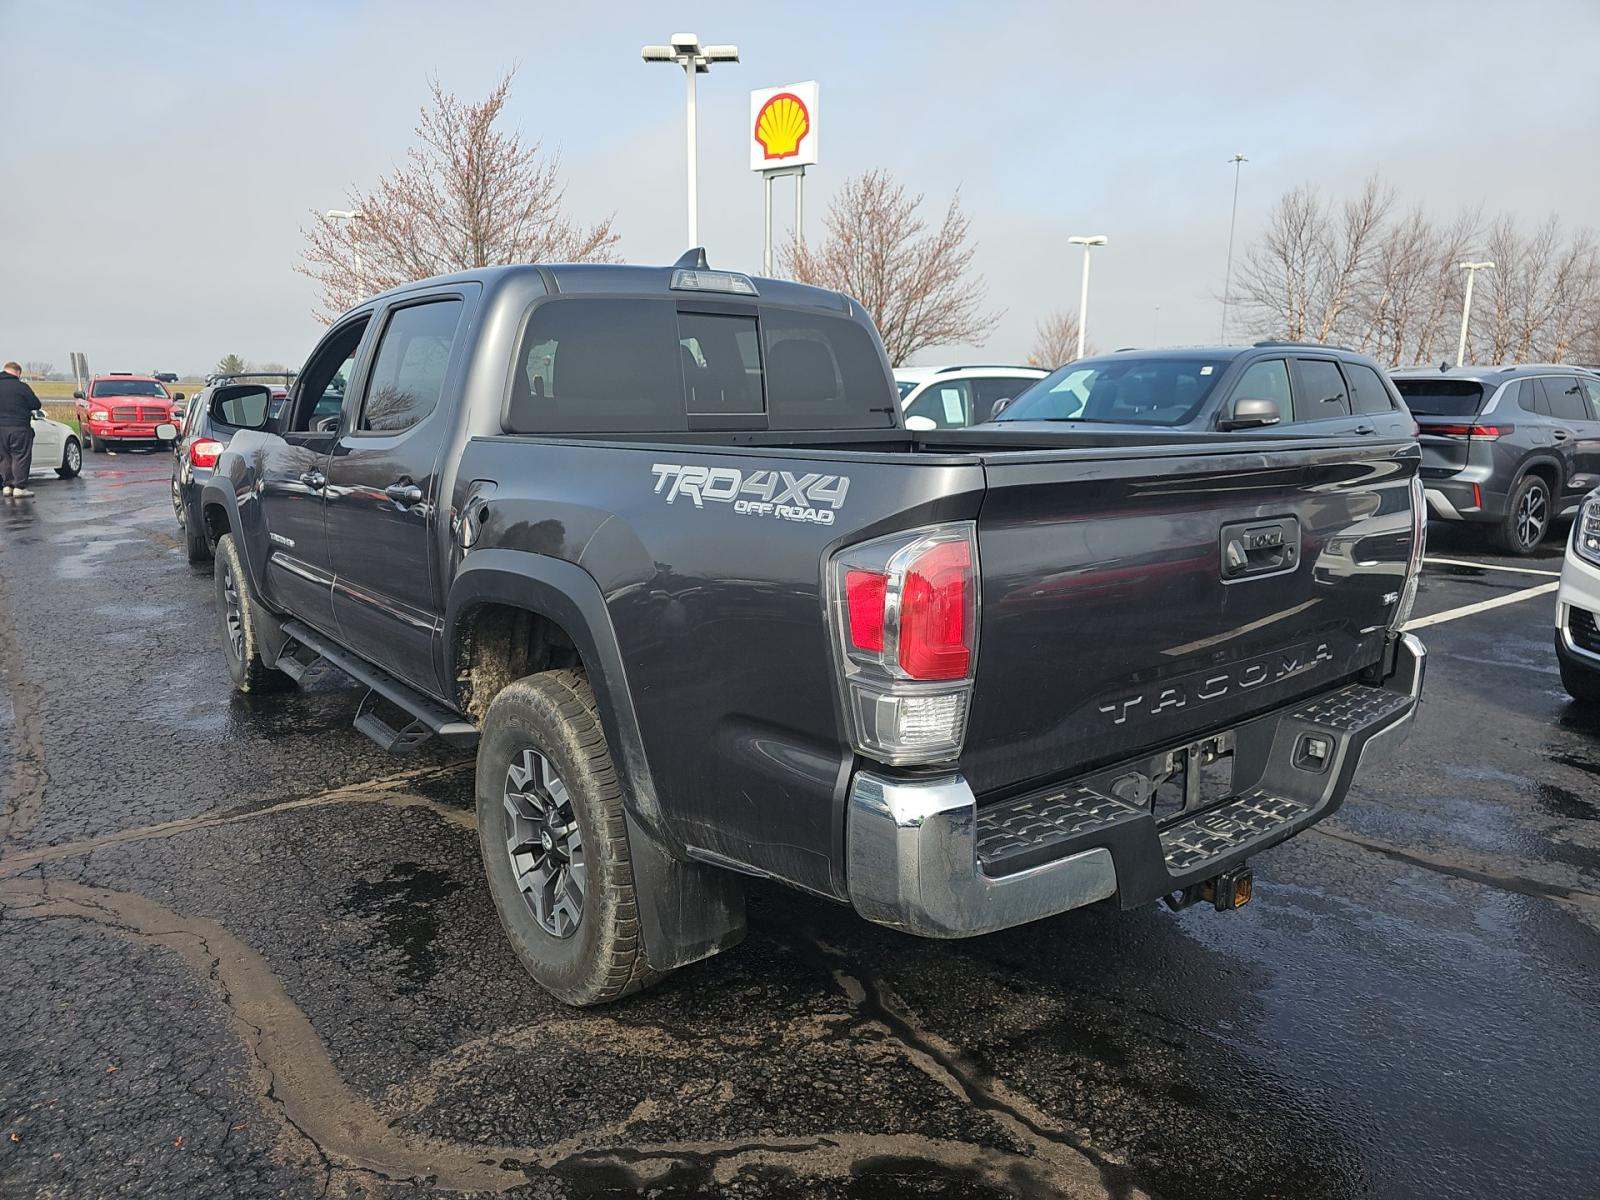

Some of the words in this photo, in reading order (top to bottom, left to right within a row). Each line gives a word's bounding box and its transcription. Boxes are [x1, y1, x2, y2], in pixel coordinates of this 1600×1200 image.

[651, 463, 742, 509] TRD
[733, 500, 774, 516] OFF
[774, 504, 836, 526] ROAD
[1099, 643, 1334, 725] TACOMA
